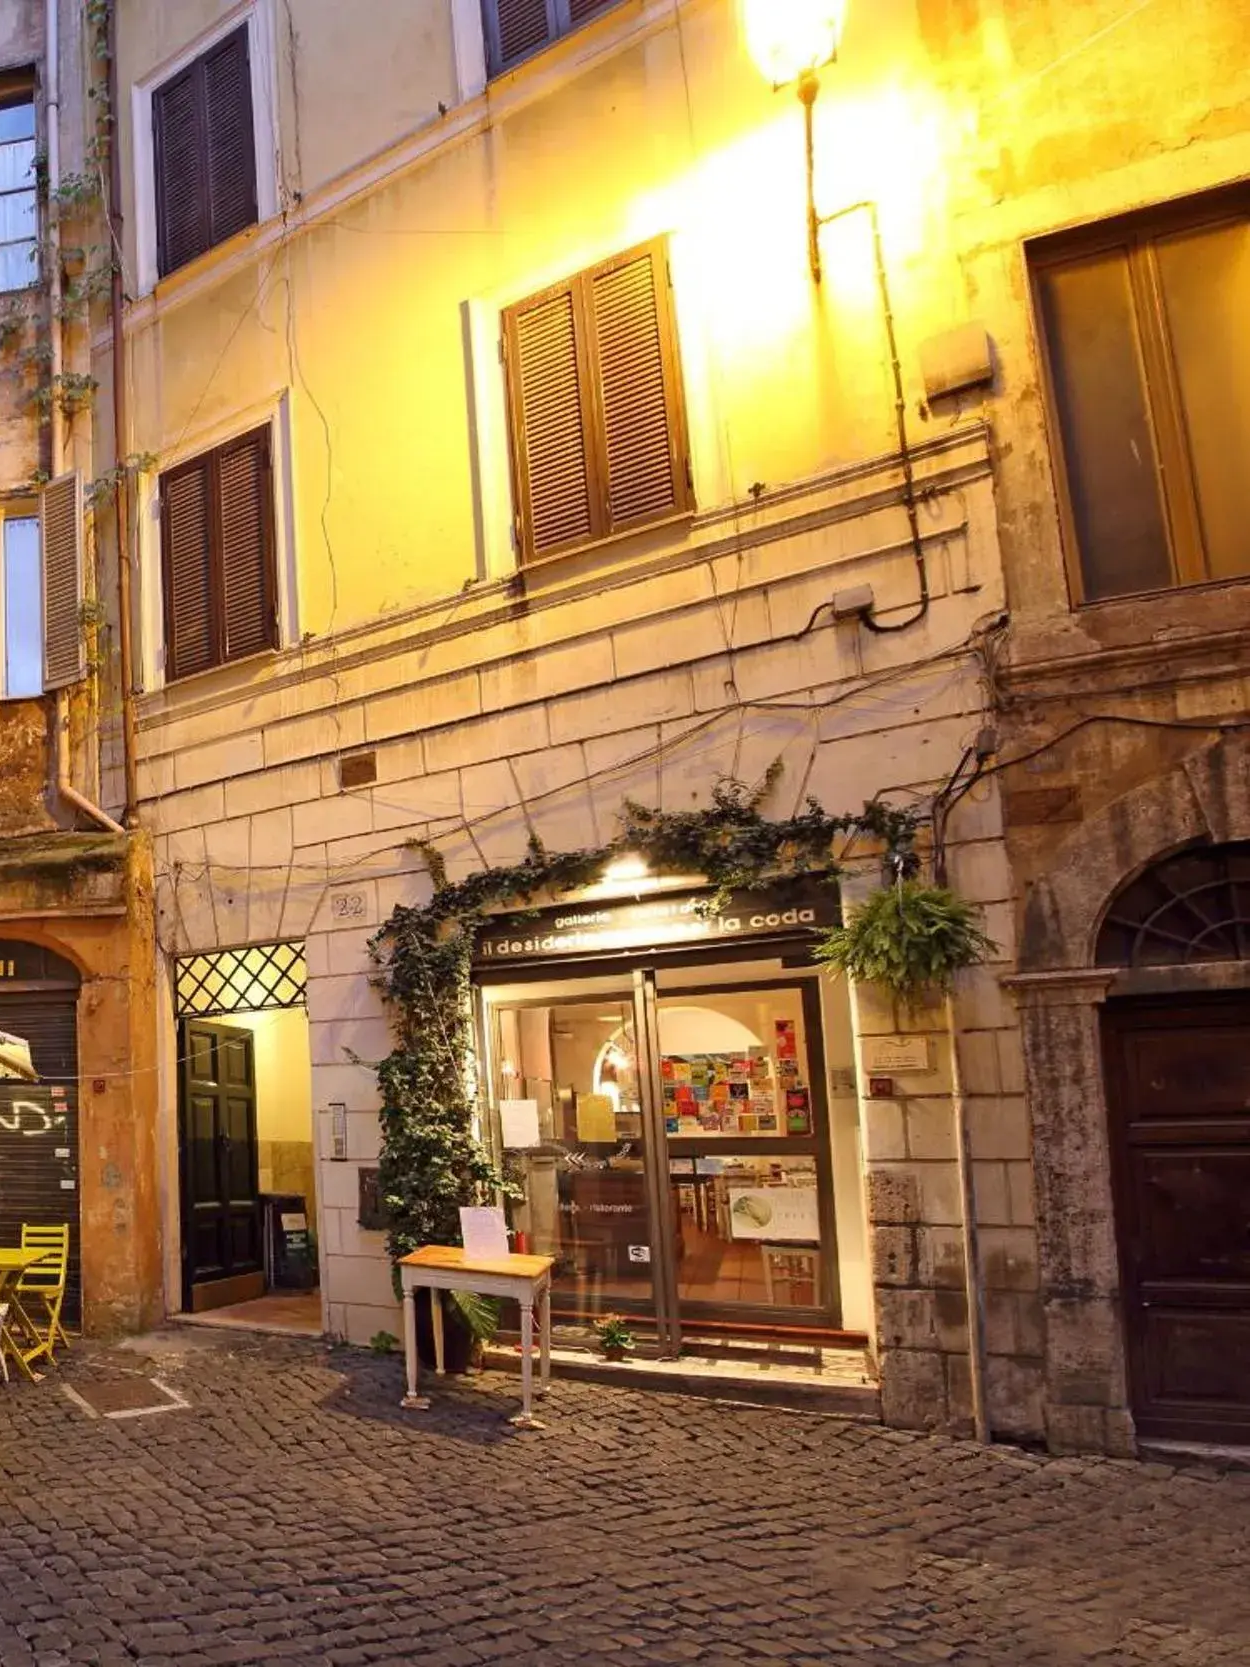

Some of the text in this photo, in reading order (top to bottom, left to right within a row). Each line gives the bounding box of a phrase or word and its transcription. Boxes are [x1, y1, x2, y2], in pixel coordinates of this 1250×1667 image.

[482, 941, 493, 955] il
[719, 916, 741, 933] la
[750, 908, 815, 928] coda
